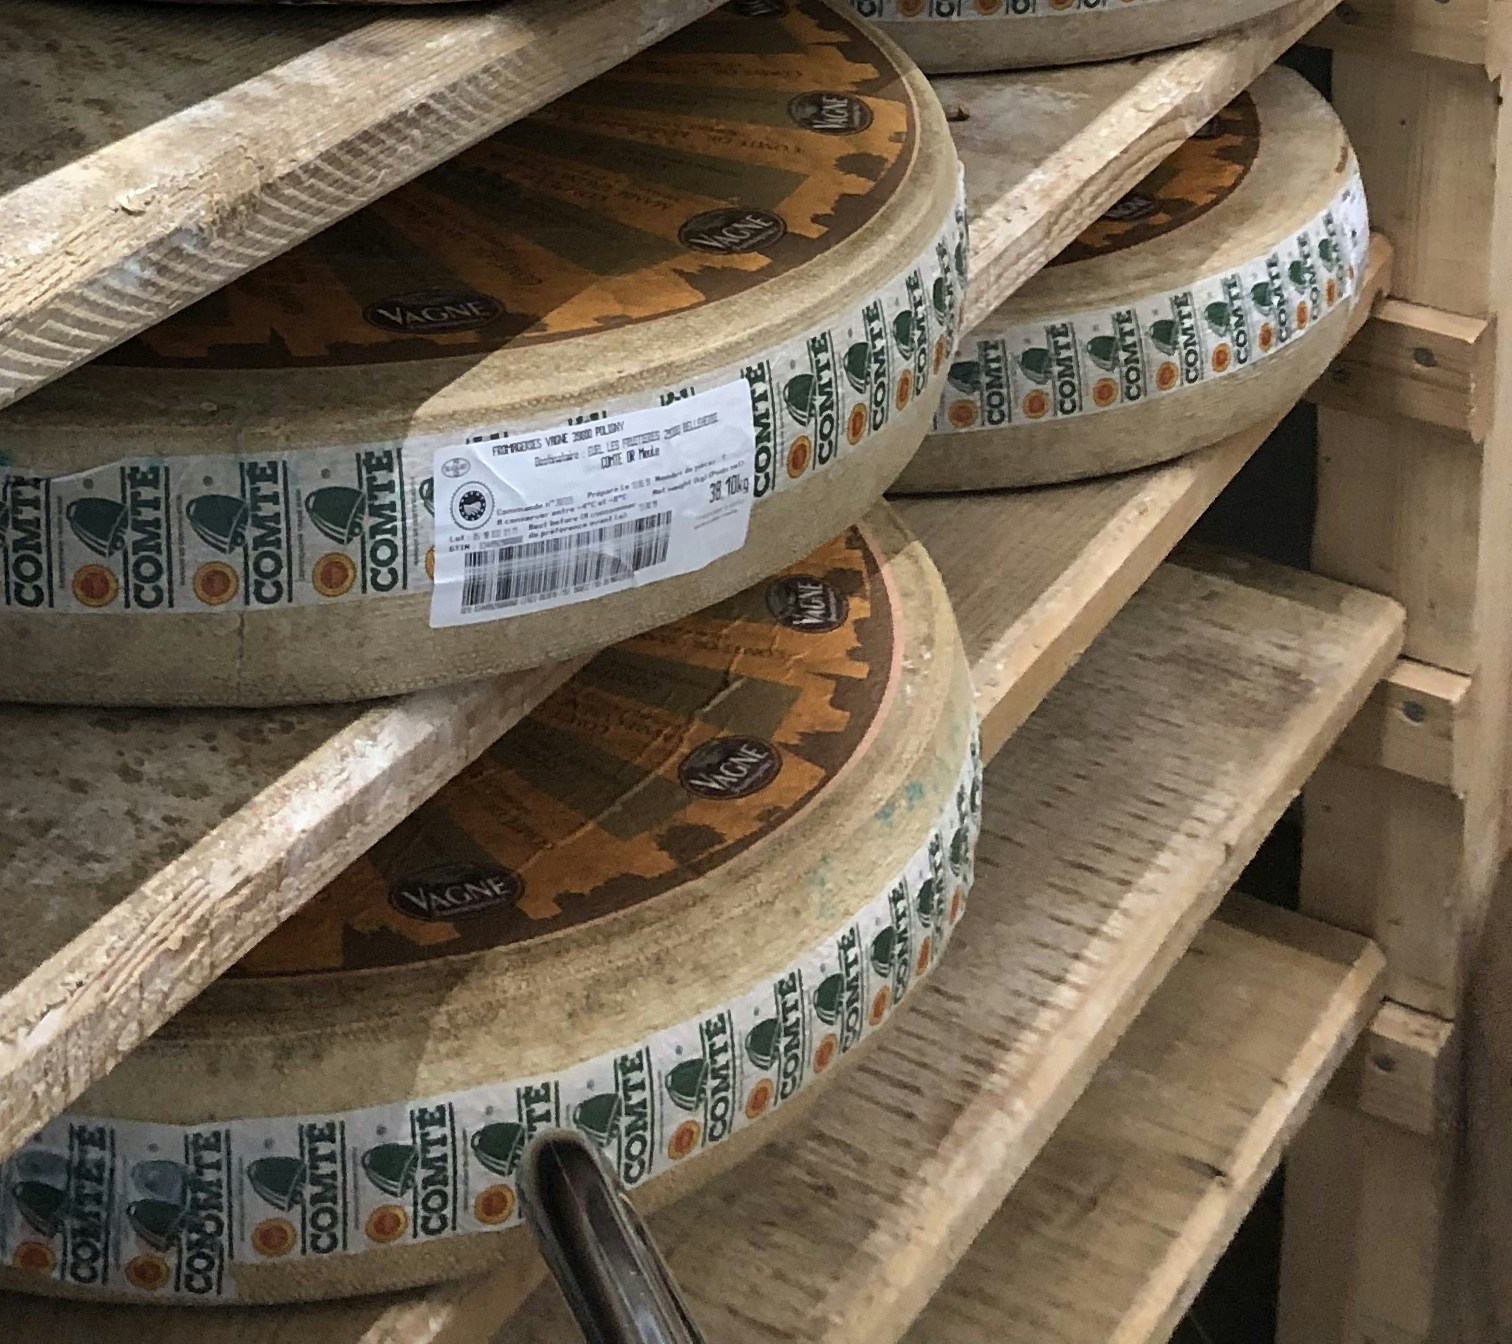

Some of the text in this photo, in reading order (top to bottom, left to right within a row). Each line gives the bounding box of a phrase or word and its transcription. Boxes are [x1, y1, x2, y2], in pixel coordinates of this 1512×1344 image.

[698, 213, 775, 250] VAGNE
[377, 296, 487, 327] VAGNE
[691, 745, 765, 792] VAGNE
[401, 876, 506, 912] VAGNE
